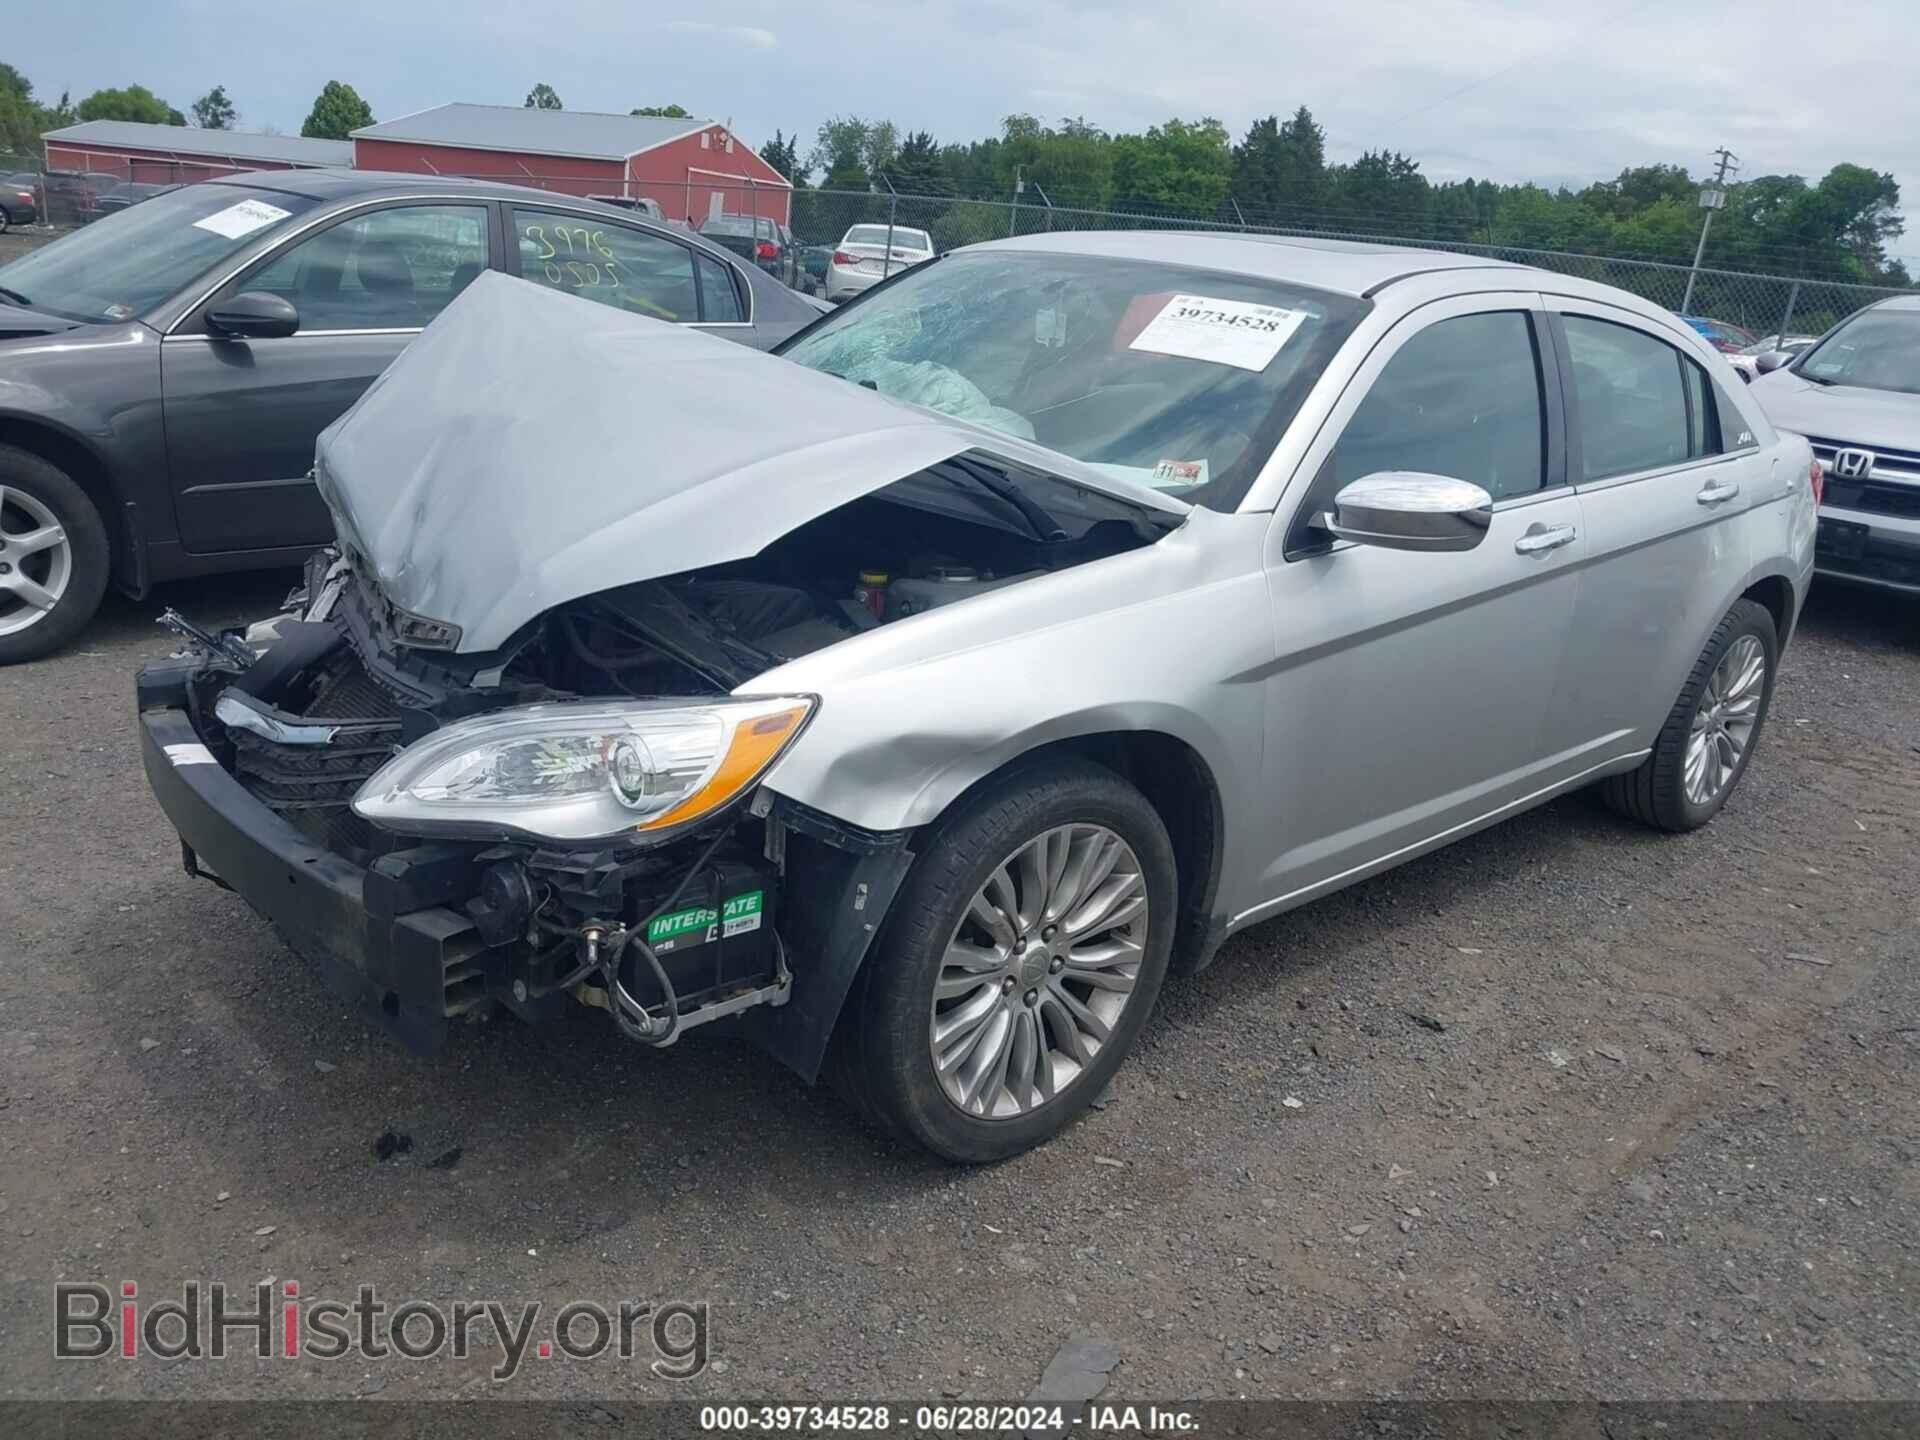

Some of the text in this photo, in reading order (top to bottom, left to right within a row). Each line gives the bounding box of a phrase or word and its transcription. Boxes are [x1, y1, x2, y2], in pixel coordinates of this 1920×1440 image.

[526, 226, 613, 259] 3976
[1171, 307, 1281, 332] 39734528
[653, 896, 758, 936] INTERSATE
